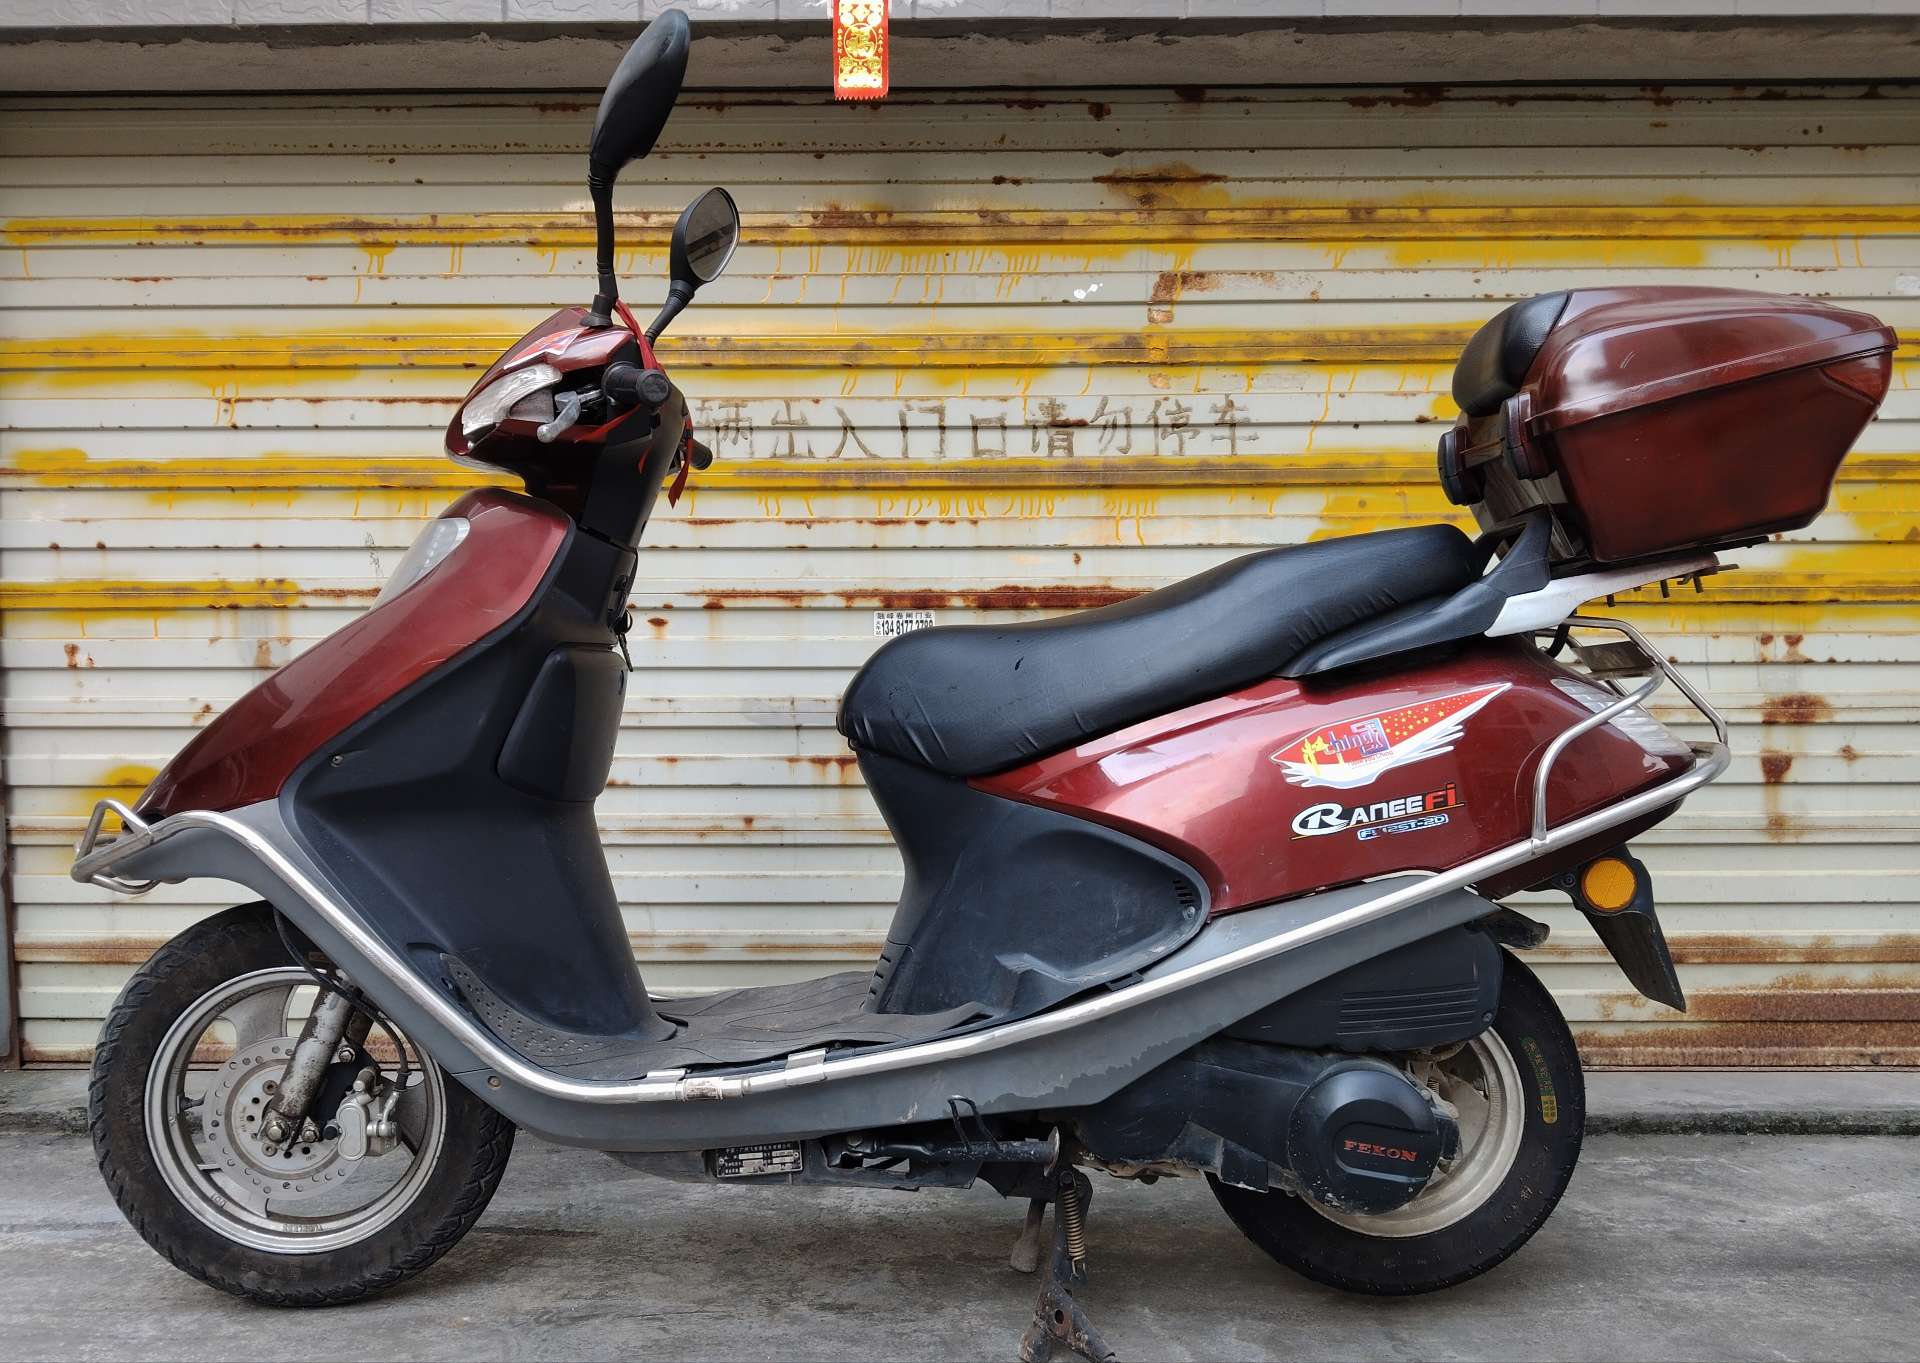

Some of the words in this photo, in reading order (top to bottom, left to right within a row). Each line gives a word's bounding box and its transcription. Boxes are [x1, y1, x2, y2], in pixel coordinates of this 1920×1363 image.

[882, 620, 894, 635] 134
[896, 620, 913, 635] 8177
[1343, 1139, 1418, 1162] FEKON
